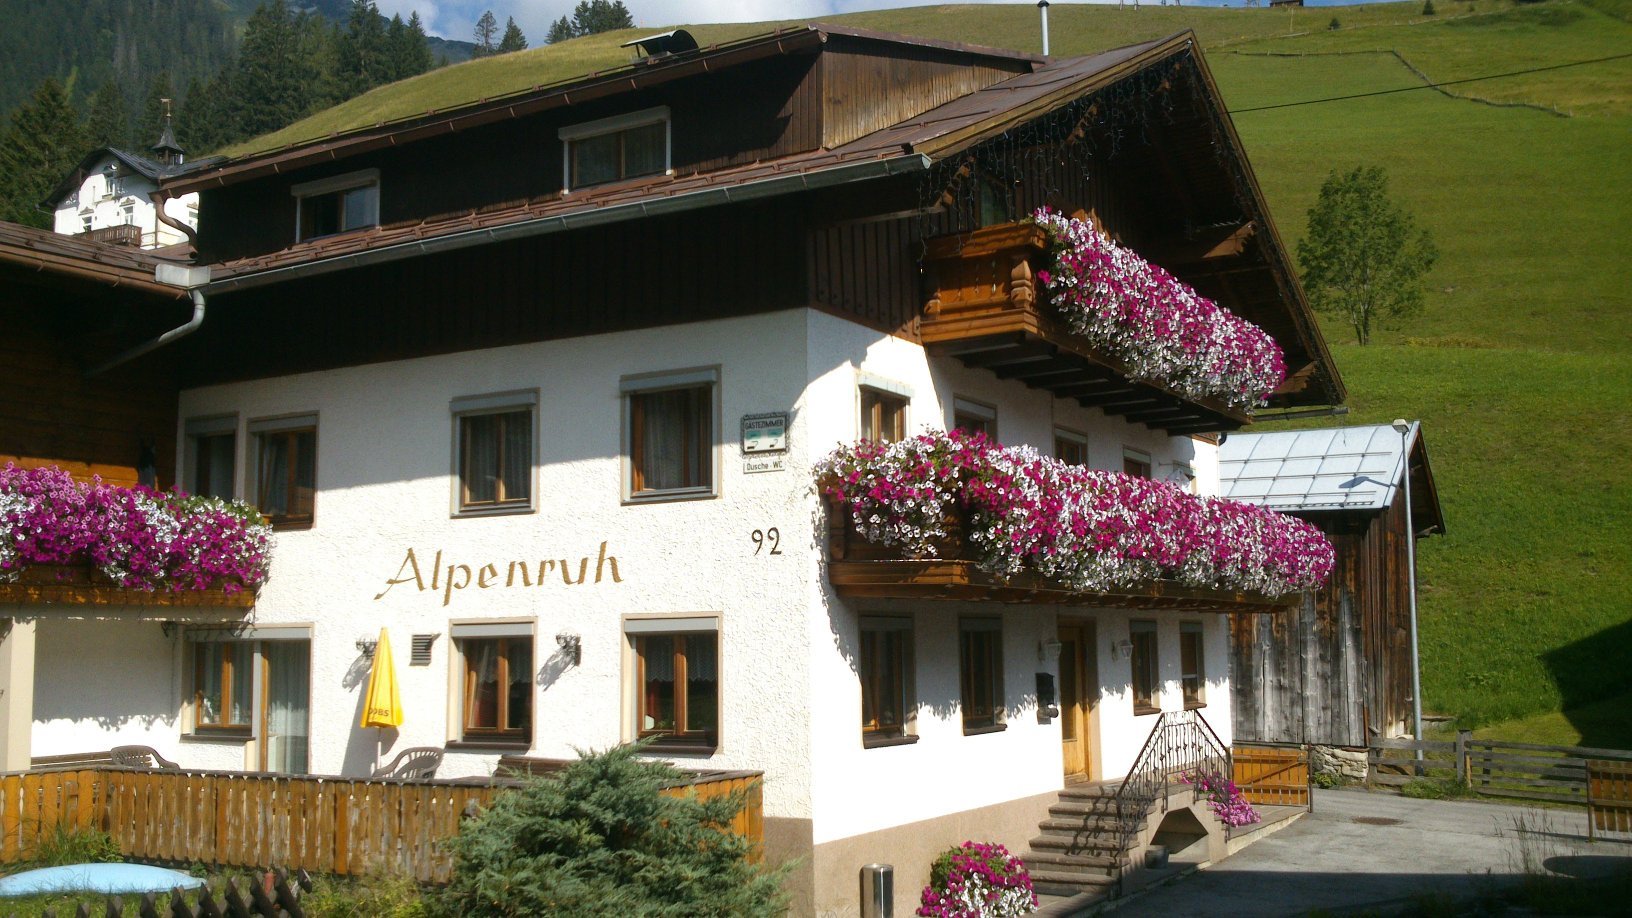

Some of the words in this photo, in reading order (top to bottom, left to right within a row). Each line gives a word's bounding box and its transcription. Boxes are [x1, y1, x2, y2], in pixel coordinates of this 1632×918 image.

[746, 462, 769, 471] Dusche
[751, 526, 782, 556] 92
[374, 540, 624, 607] Alpenruh
